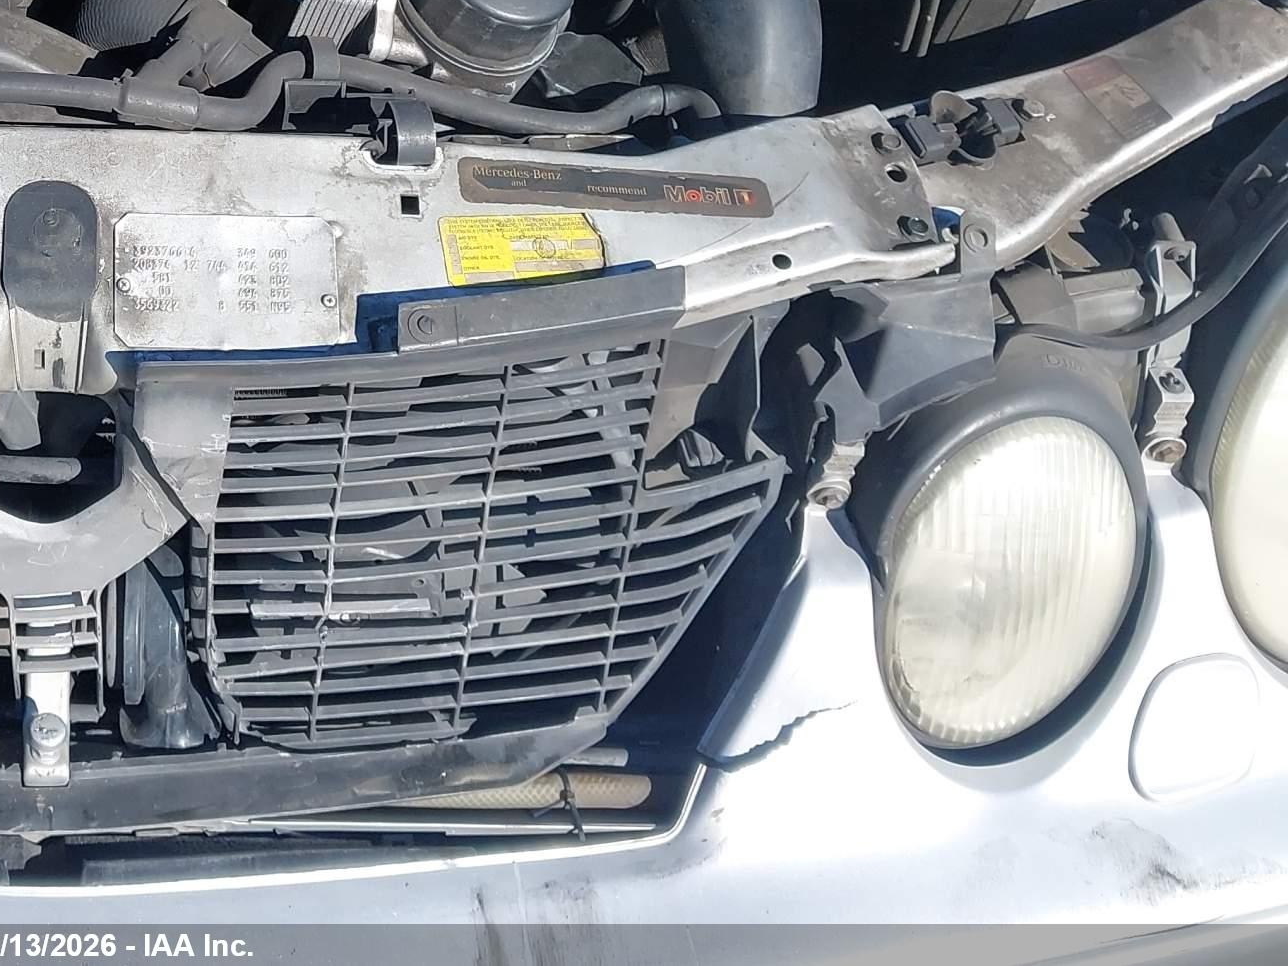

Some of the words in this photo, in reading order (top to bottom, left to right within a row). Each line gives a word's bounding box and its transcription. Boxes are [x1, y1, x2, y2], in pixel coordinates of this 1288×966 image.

[472, 165, 563, 181] Mercedes-Benz
[511, 179, 527, 187] and
[586, 184, 647, 197] recommend
[663, 185, 732, 206] Mobil
